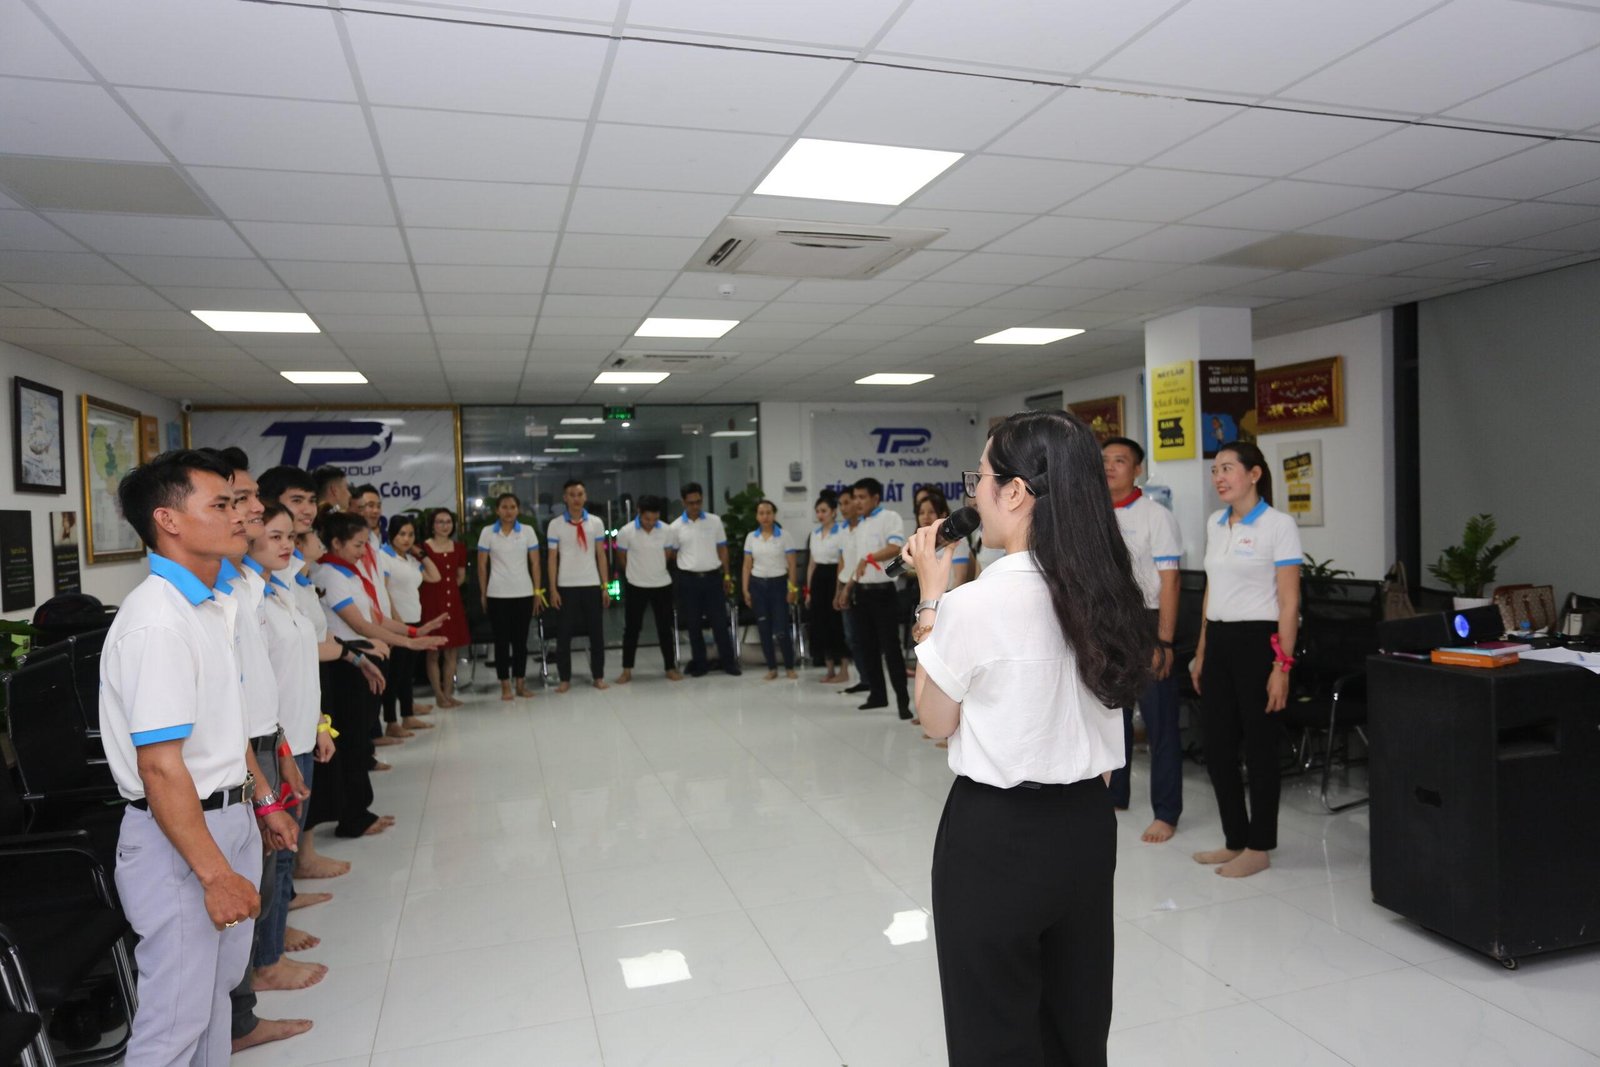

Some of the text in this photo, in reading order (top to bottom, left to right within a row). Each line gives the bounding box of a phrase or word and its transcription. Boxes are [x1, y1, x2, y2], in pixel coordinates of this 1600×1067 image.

[261, 421, 393, 473] TP
[870, 428, 931, 453] TP
[845, 459, 857, 468] Uy
[878, 459, 895, 468] Tạo
[899, 458, 925, 467] Thành
[926, 457, 949, 468] Công
[380, 481, 421, 500] Công
